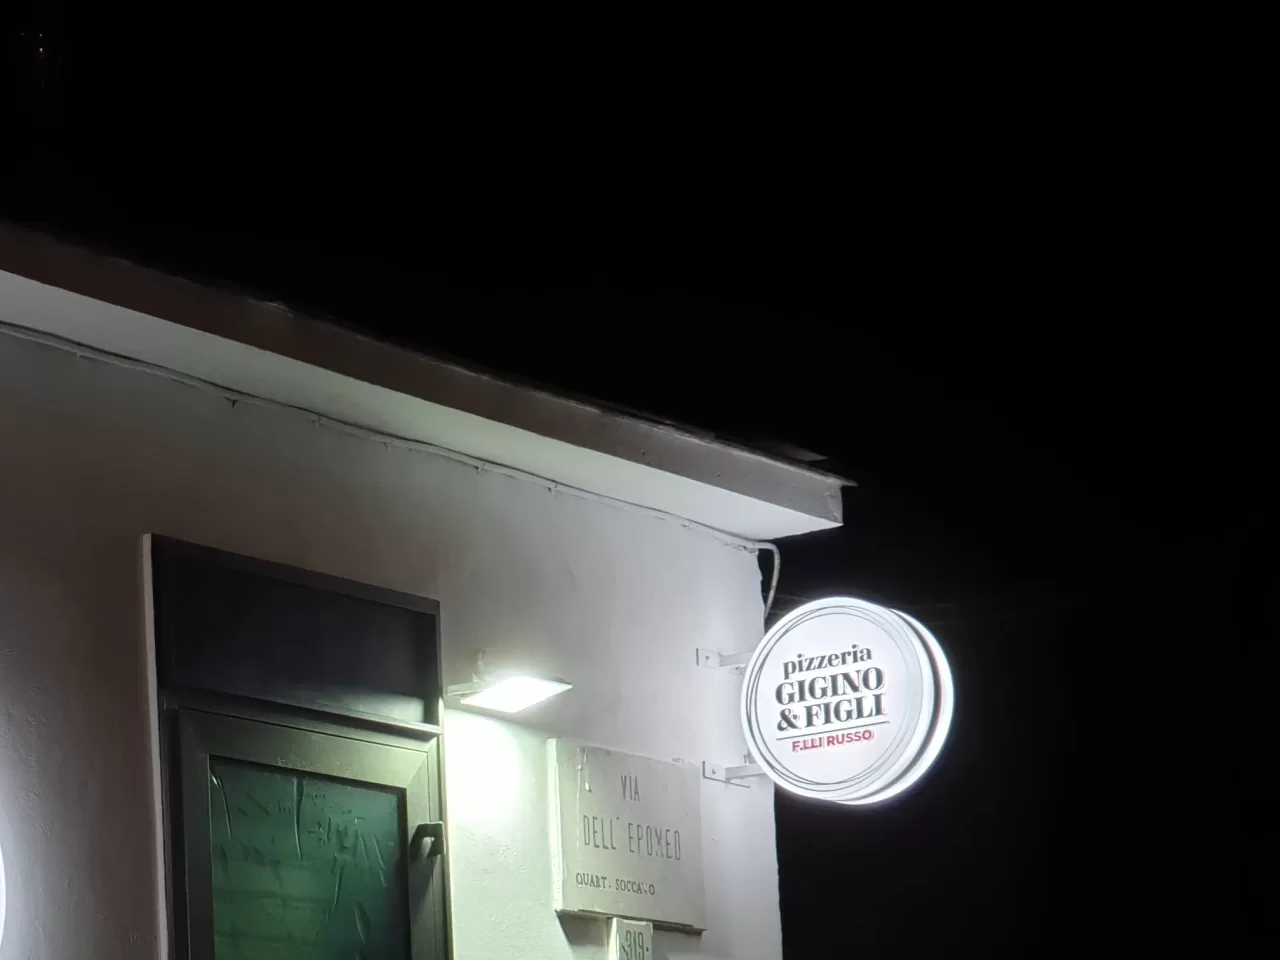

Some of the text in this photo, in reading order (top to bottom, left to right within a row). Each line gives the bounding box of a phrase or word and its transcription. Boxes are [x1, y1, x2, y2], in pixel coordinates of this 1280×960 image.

[783, 644, 872, 680] pizzeria
[775, 666, 884, 705] GIGINO
[776, 692, 885, 732] & FIGLI
[826, 729, 874, 747] RUSSO
[620, 774, 641, 802] VIA
[627, 822, 682, 861] EPOMEO
